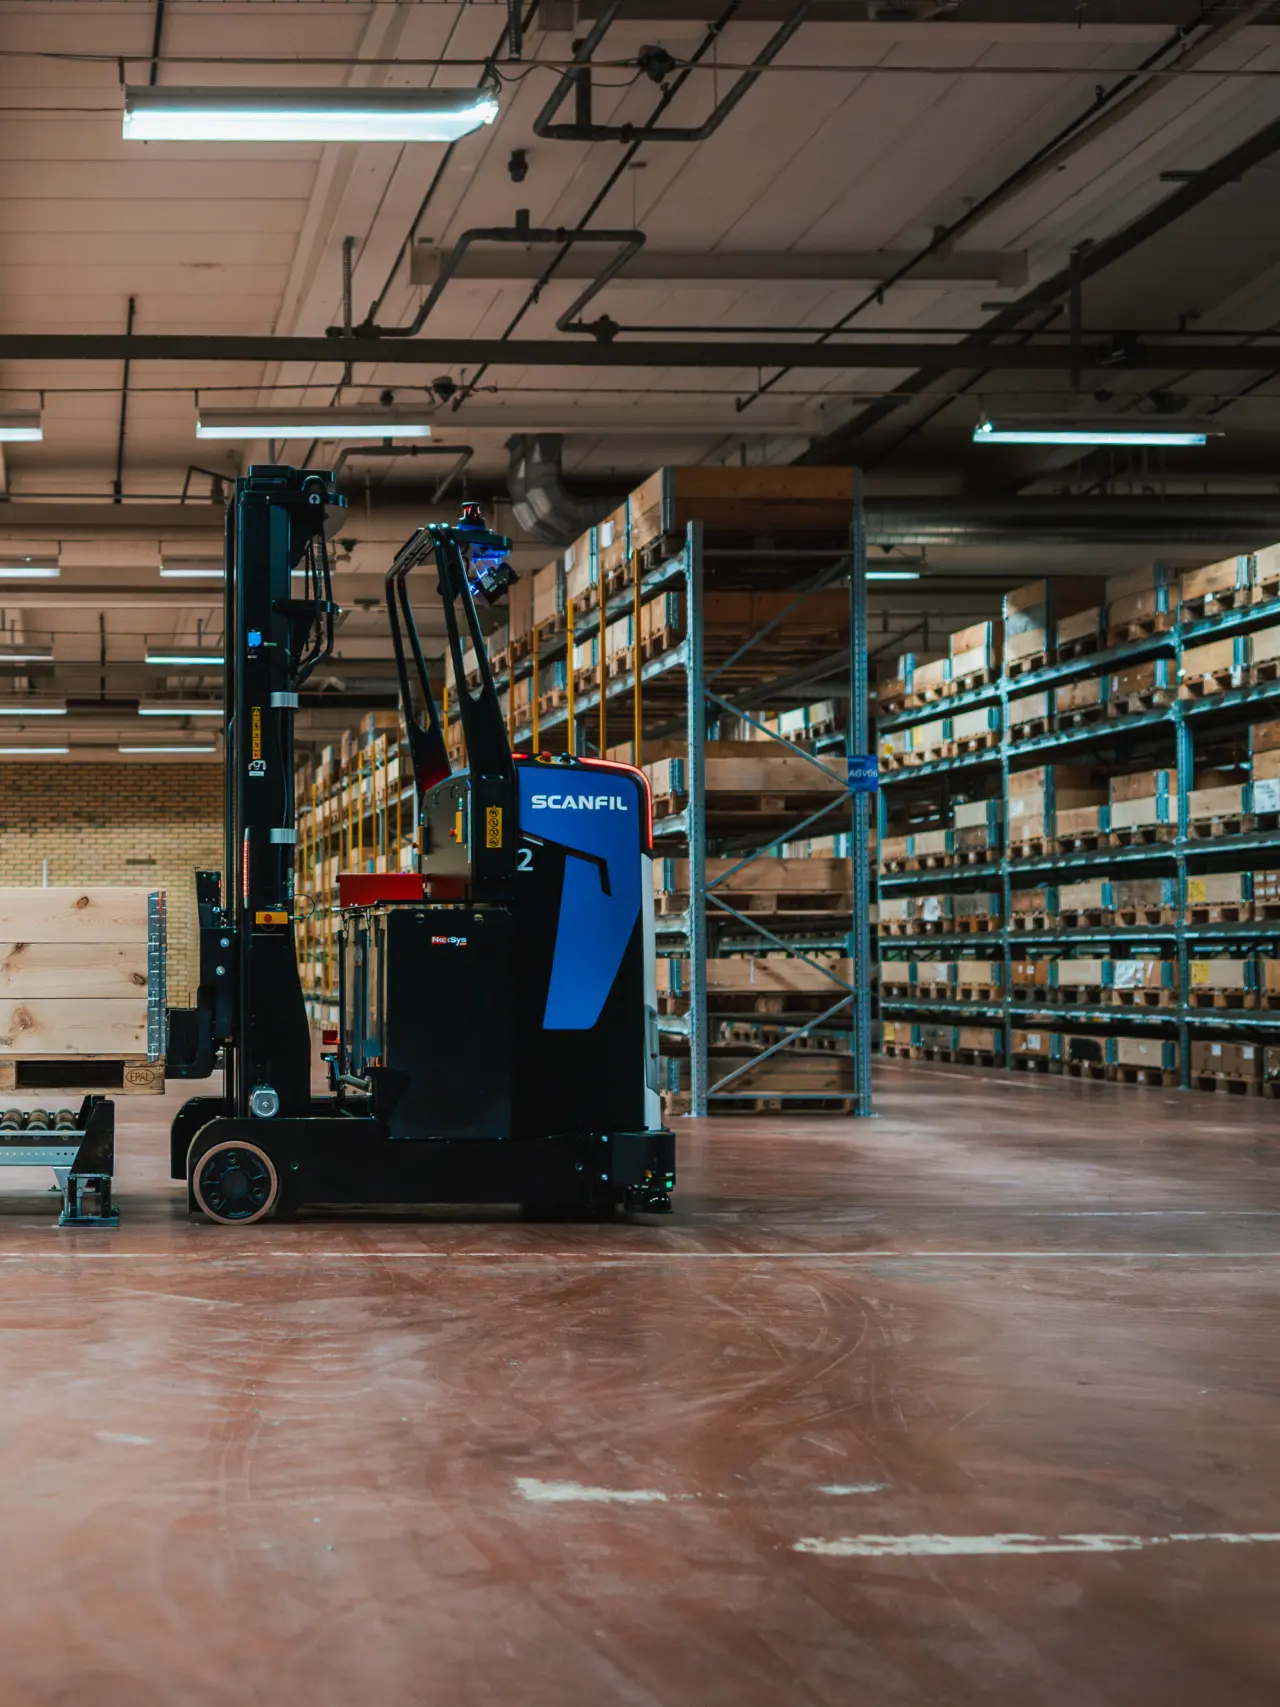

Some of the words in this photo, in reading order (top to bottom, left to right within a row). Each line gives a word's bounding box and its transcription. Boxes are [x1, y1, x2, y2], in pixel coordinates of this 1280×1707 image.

[531, 794, 628, 811] SCANFIL
[516, 848, 534, 871] 2
[130, 1072, 150, 1082] EPAL
